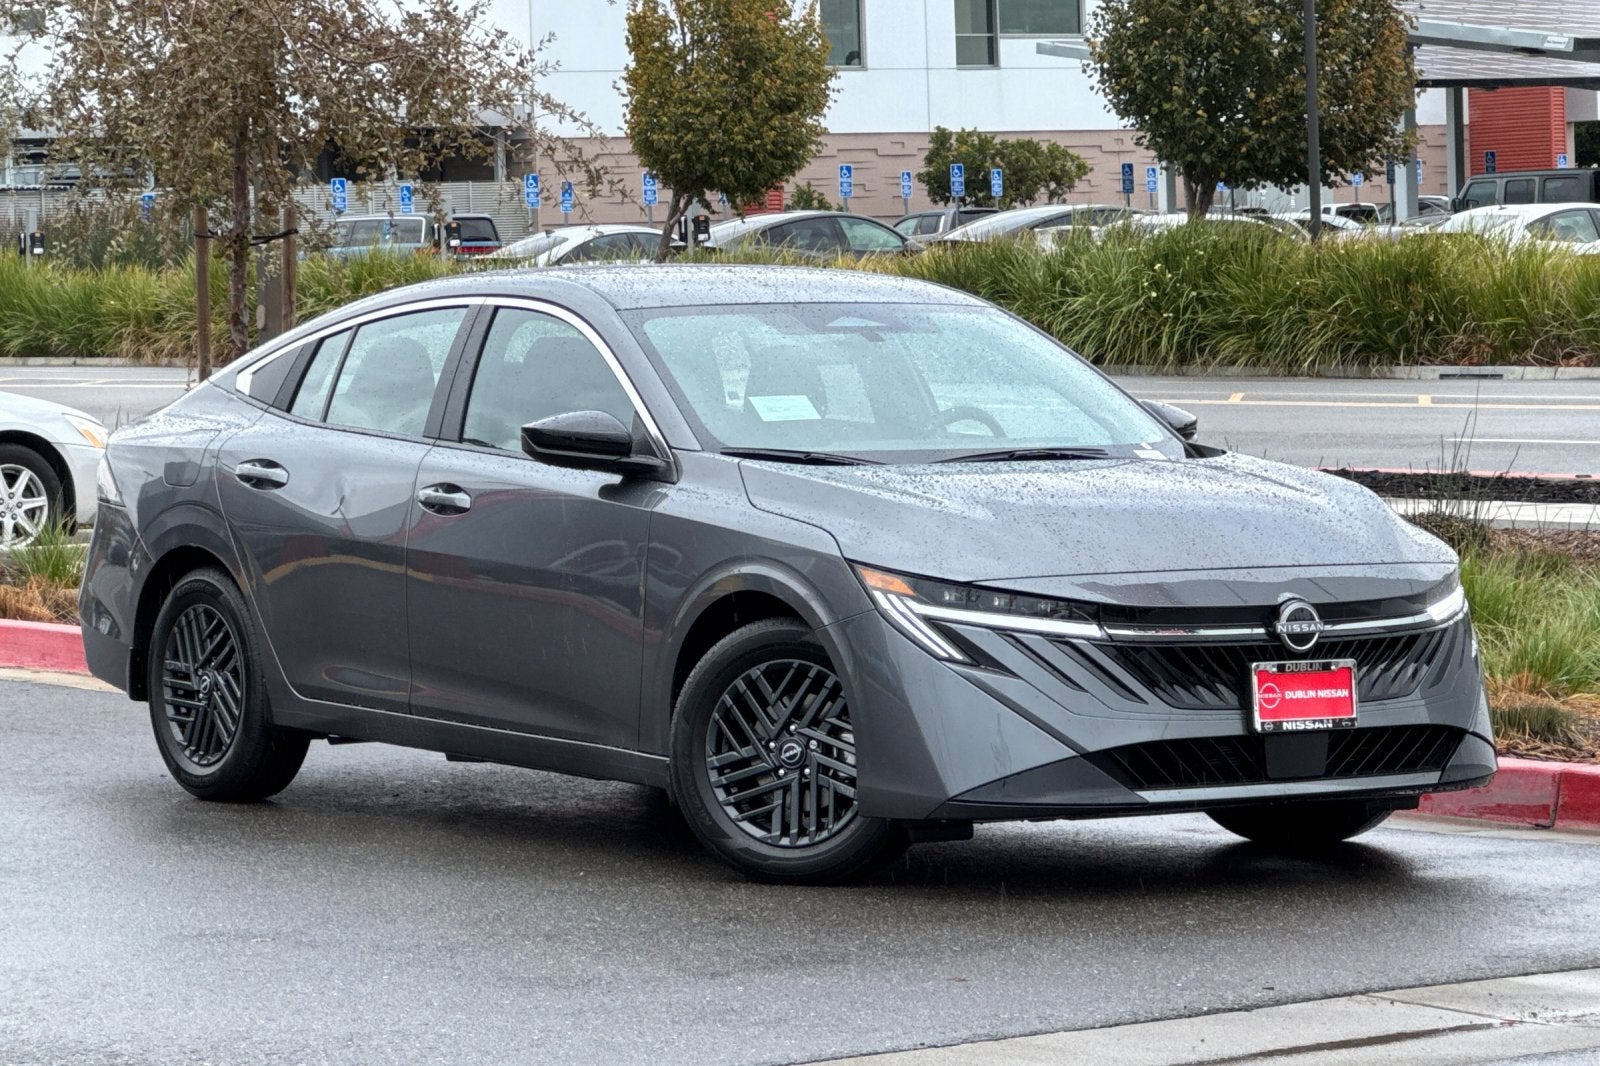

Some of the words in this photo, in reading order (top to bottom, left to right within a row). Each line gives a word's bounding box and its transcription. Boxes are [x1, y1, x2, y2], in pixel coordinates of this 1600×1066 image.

[1277, 623, 1324, 632] NISSAN
[1285, 663, 1323, 672] DUBLIN
[1285, 690, 1316, 699] DUBLIN
[1317, 689, 1349, 698] NISSAN
[1282, 719, 1333, 730] NISSAN
